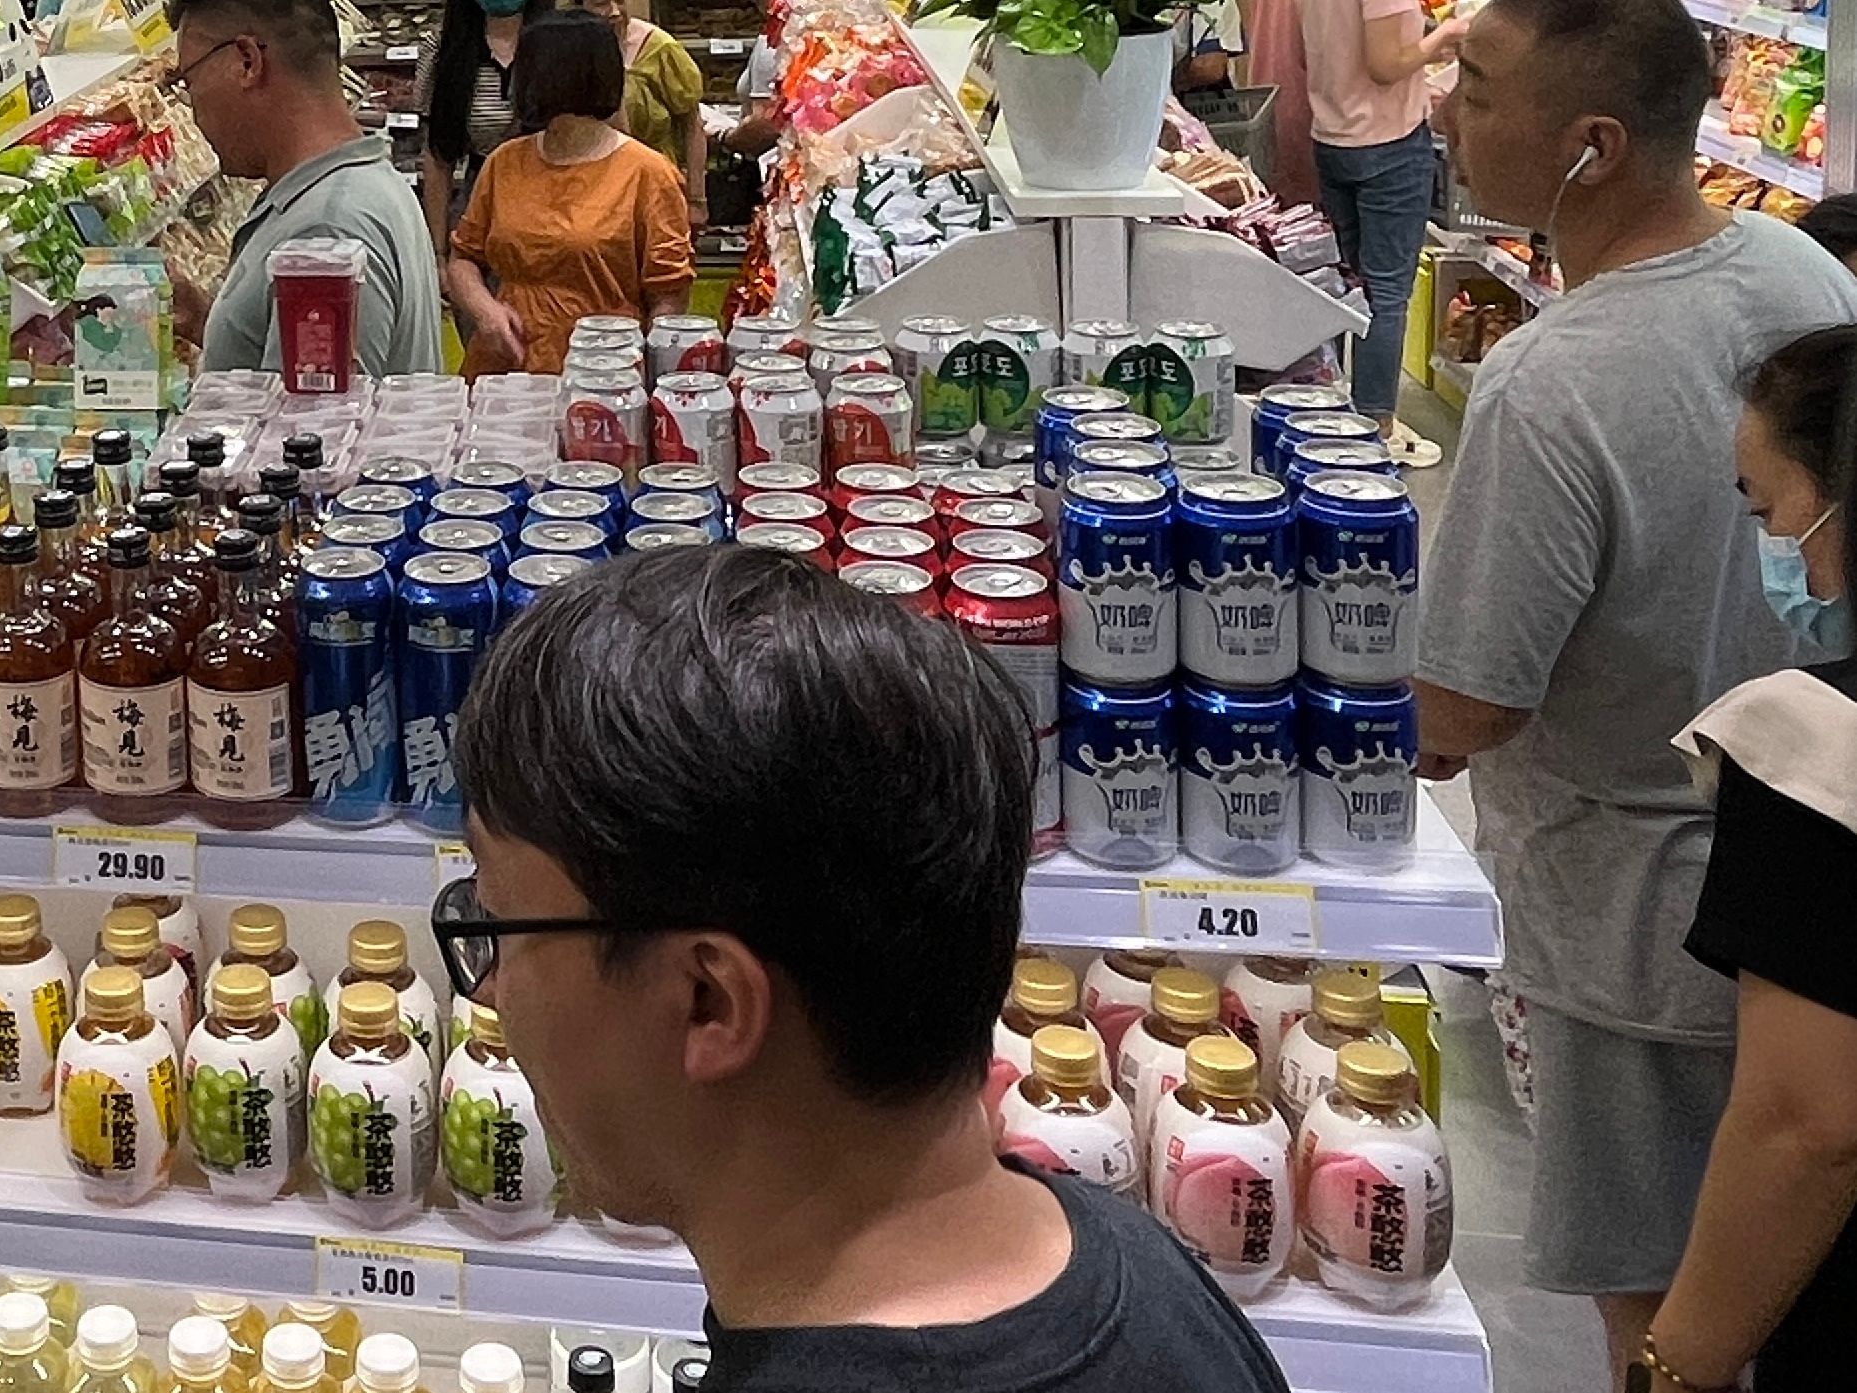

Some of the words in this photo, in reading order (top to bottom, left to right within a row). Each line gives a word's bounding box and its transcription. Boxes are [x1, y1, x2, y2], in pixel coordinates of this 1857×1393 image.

[1220, 603, 1274, 631] 奶啤
[98, 851, 166, 881] 29.90
[1198, 907, 1258, 937] 4.20
[362, 1265, 416, 1296] 5.00
